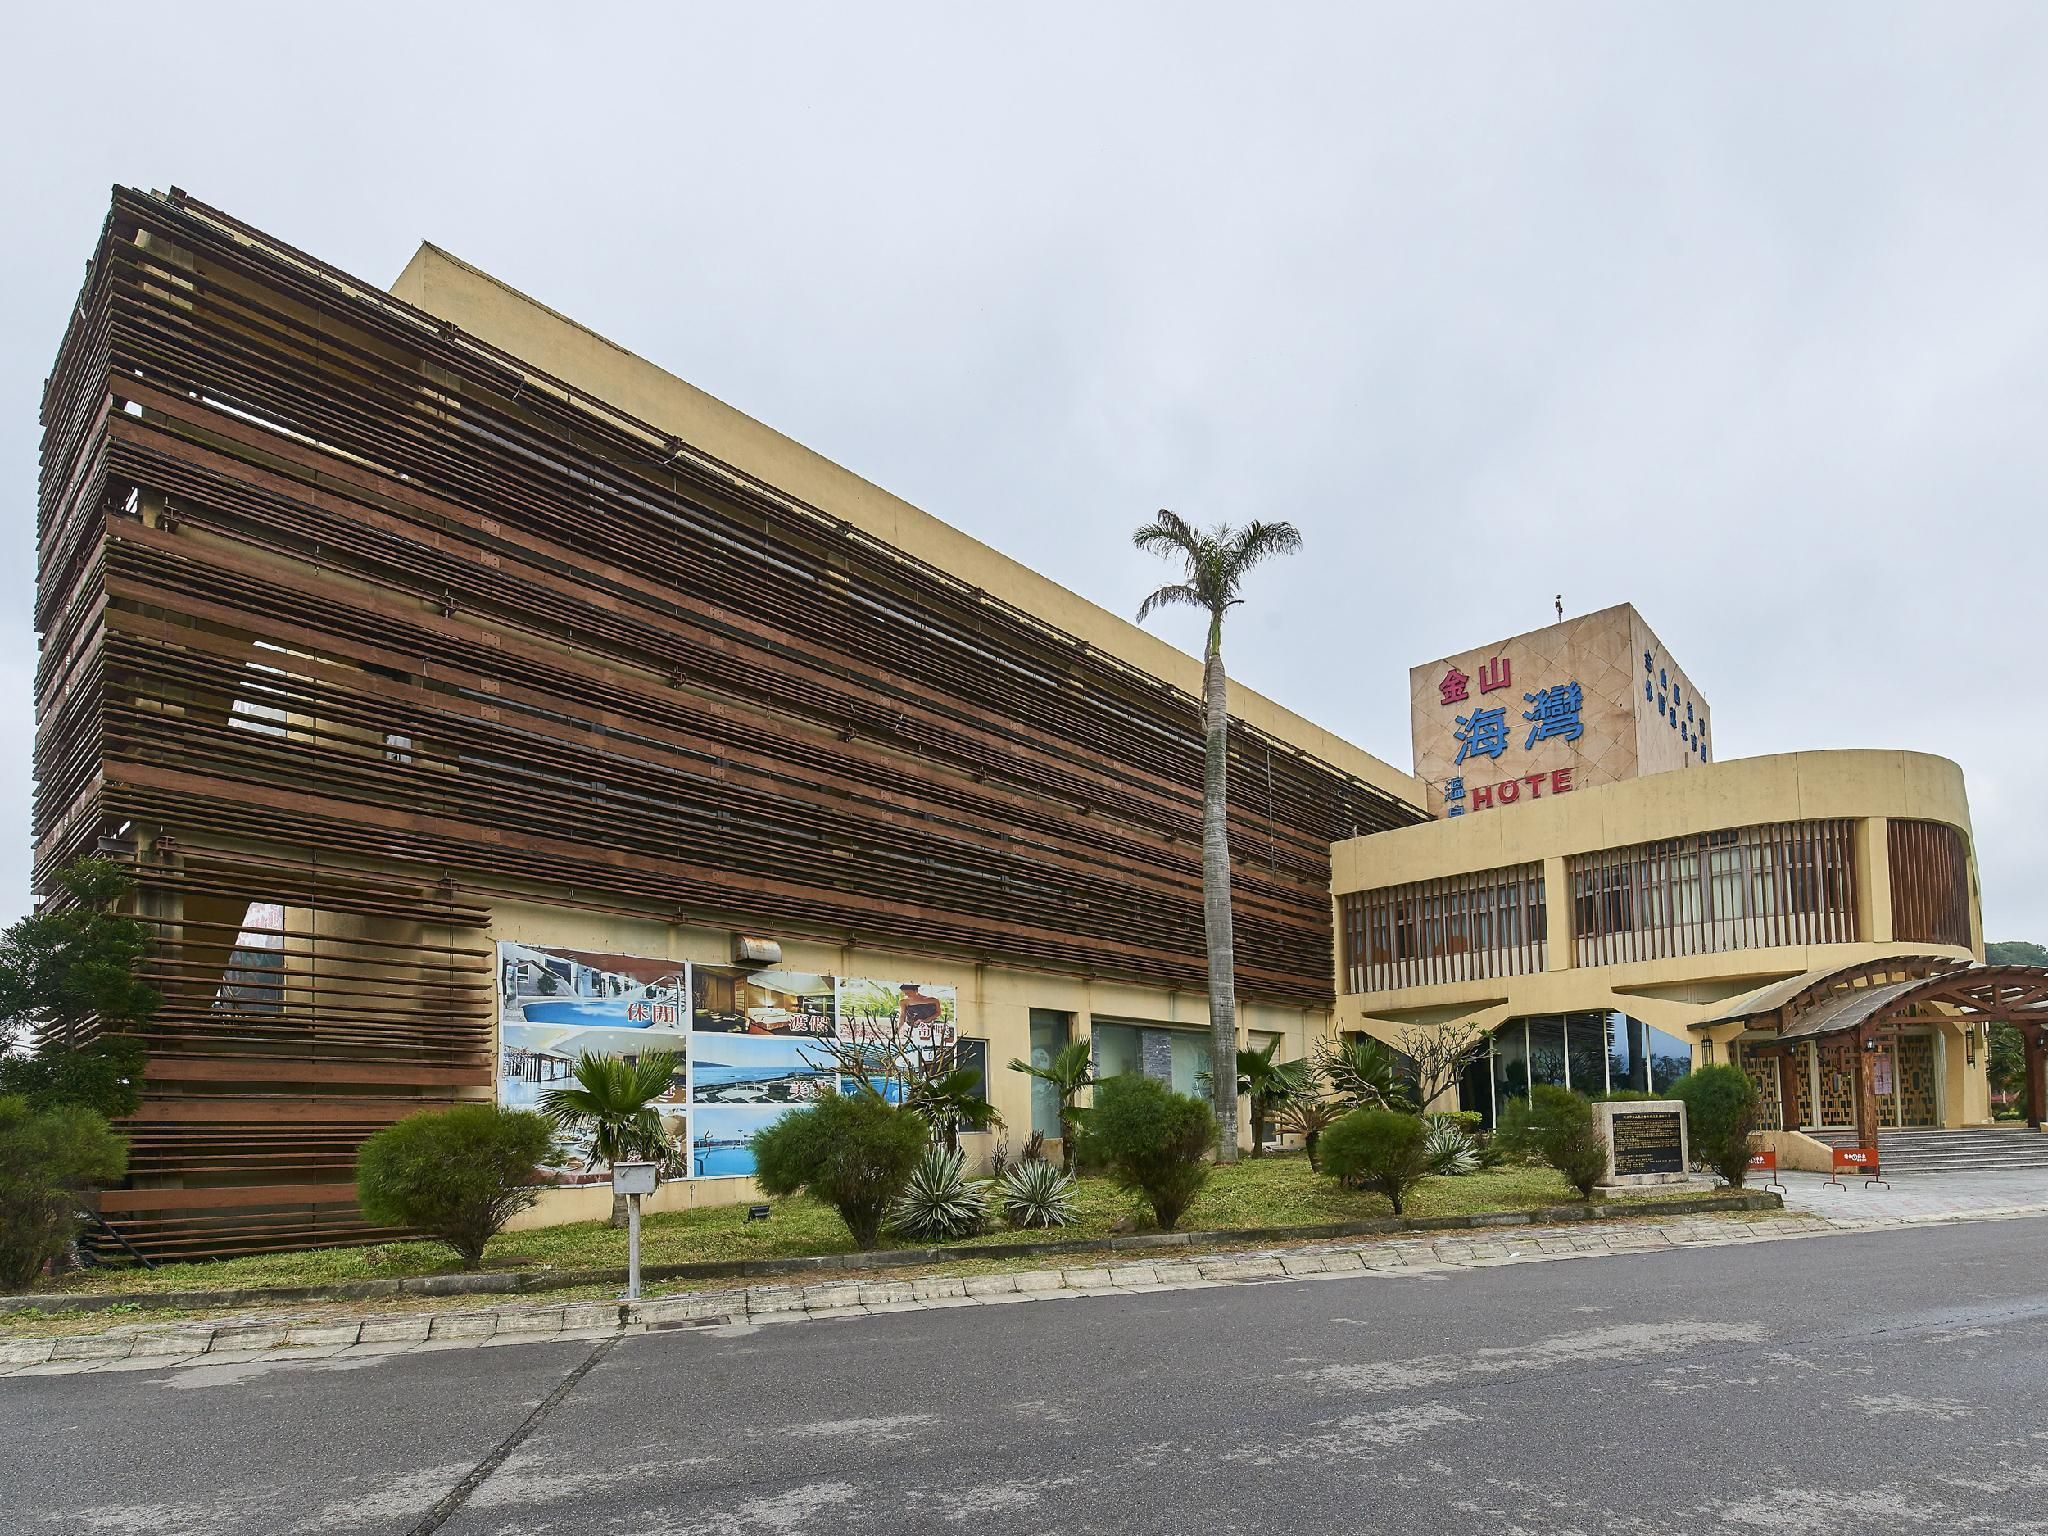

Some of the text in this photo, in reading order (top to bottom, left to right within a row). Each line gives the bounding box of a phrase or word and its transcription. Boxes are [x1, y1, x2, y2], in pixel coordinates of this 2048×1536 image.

[1438, 656, 1512, 706] 金山
[1453, 681, 1585, 766] 海灣
[1472, 768, 1574, 811] HOTE
